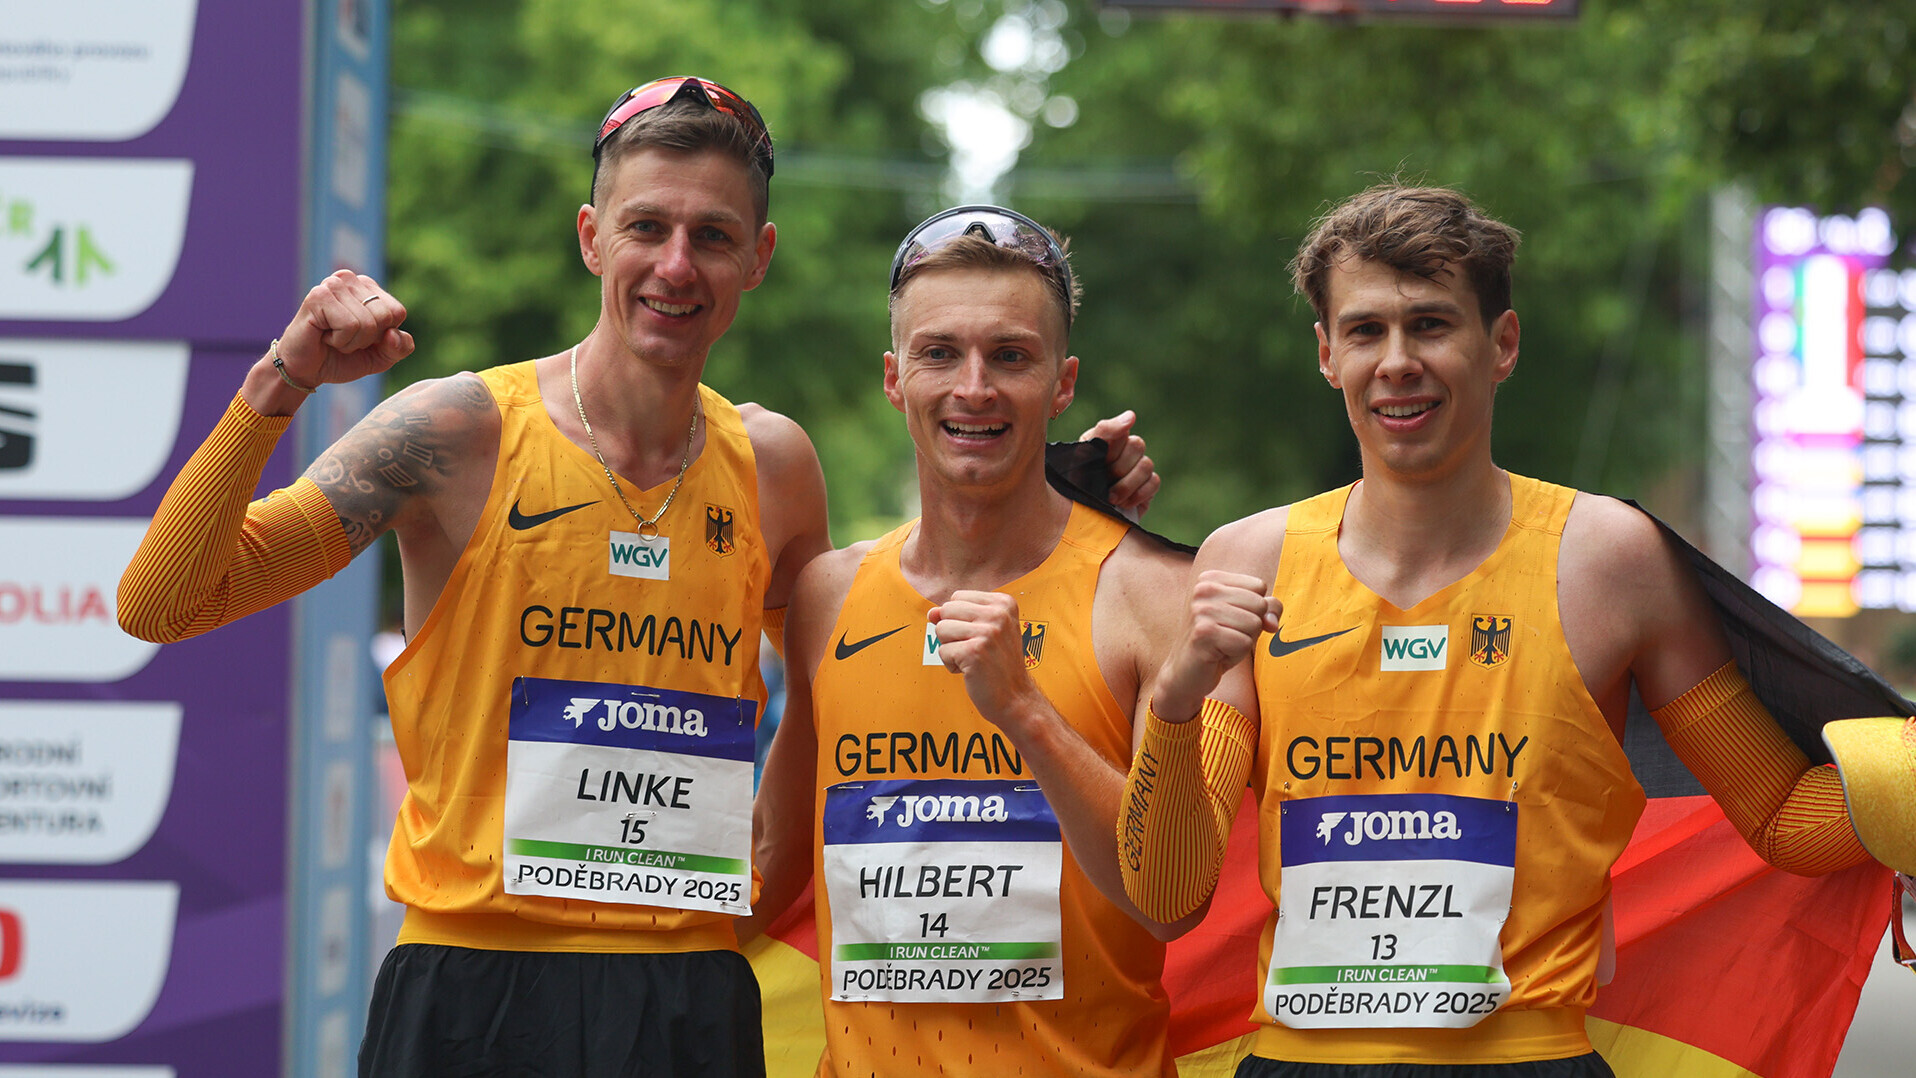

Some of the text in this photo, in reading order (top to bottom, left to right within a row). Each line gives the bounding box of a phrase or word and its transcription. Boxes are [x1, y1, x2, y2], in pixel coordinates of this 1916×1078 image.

[611, 543, 668, 568] WGV
[520, 605, 742, 666] GERMANY
[1383, 637, 1446, 659] WGV
[835, 732, 1022, 776] GERMAN
[1286, 732, 1529, 780] GERMANY
[577, 768, 694, 809] LINKE
[1124, 740, 1158, 872] GERMANY
[619, 818, 648, 844] 15
[585, 848, 591, 860] I
[592, 848, 626, 863] RUN
[518, 863, 742, 902] PODĚBRADY 2025
[859, 865, 1024, 898] HILBERT
[1309, 884, 1463, 920] FRENZL
[919, 912, 949, 938] 14
[895, 946, 928, 959] RUN
[1370, 933, 1398, 960] 13
[843, 962, 1052, 992] PODĚBRADY 2025
[1343, 969, 1377, 982] RUN
[1275, 986, 1501, 1016] PODĚBRADY 2025
